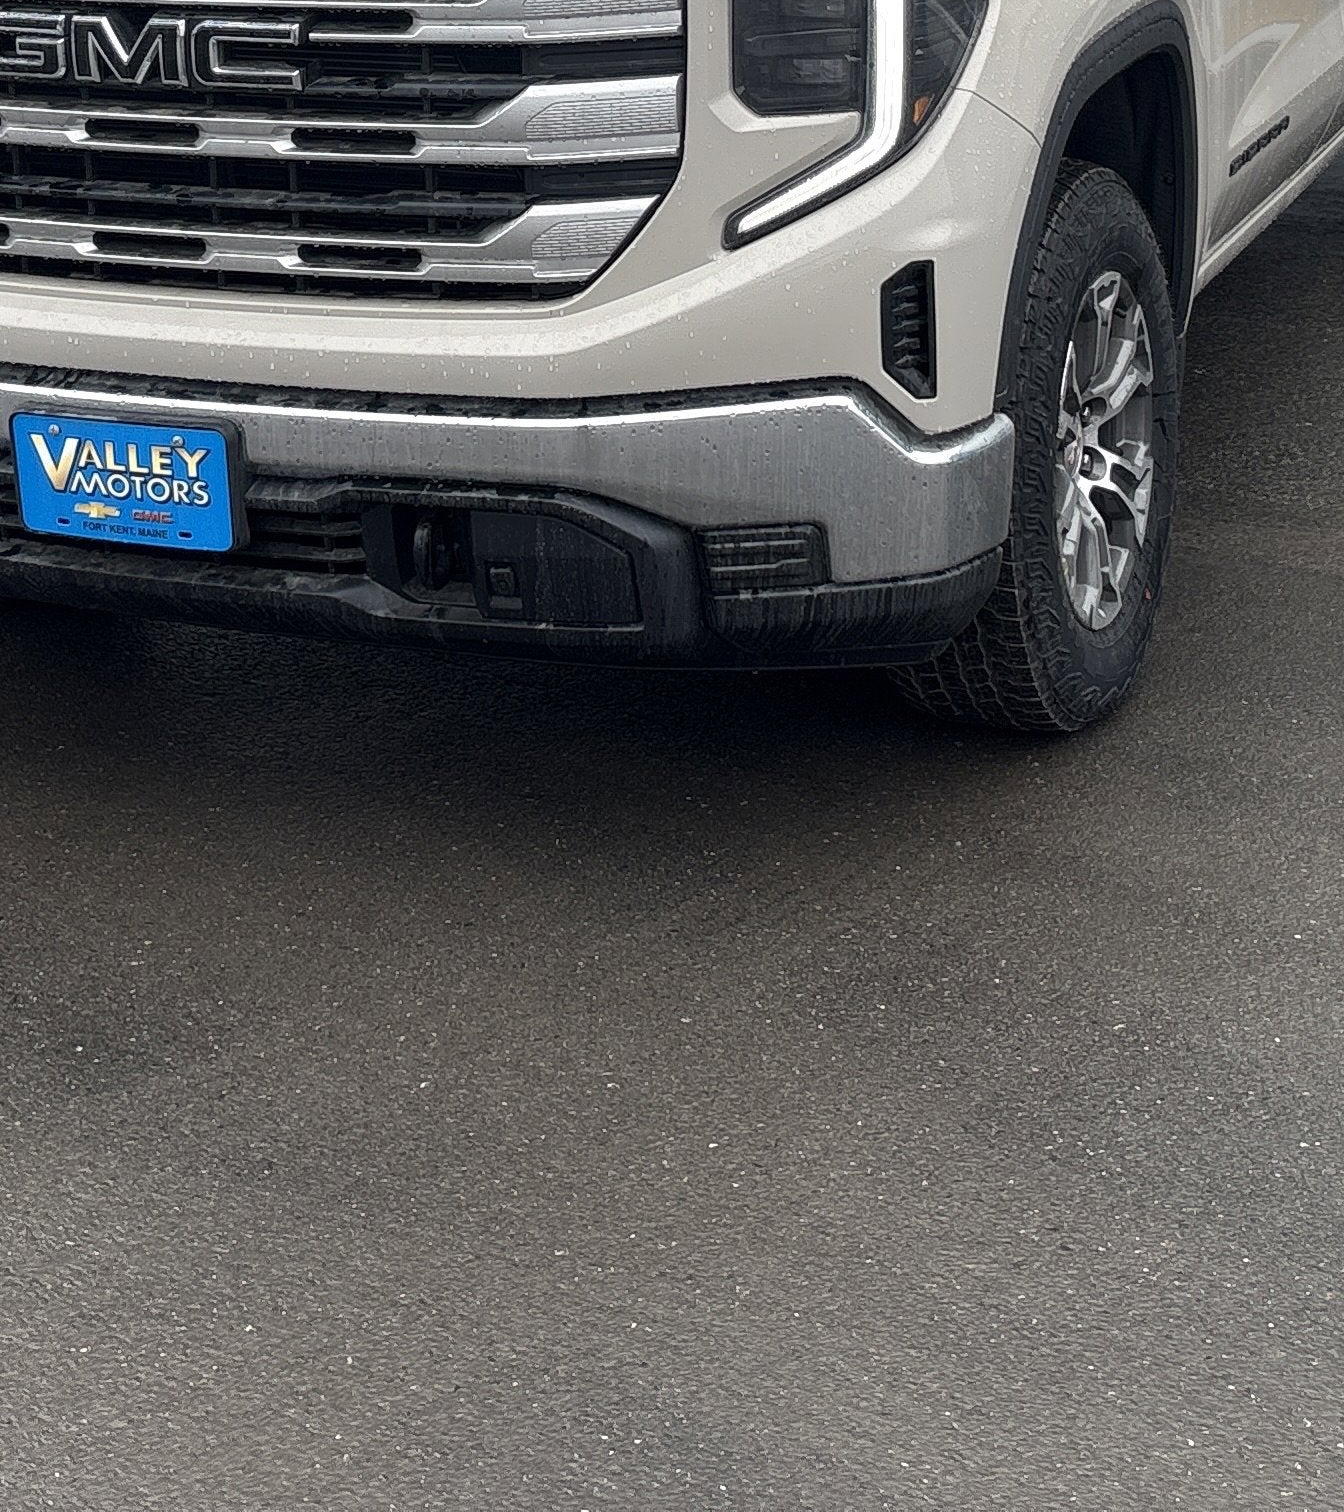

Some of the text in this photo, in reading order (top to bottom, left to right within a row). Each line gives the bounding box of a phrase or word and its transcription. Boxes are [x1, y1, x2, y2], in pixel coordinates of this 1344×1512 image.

[28, 432, 210, 491] VALLEY
[70, 471, 211, 506] MOTORS
[82, 521, 107, 533] FORT
[138, 528, 169, 540] MAINE
